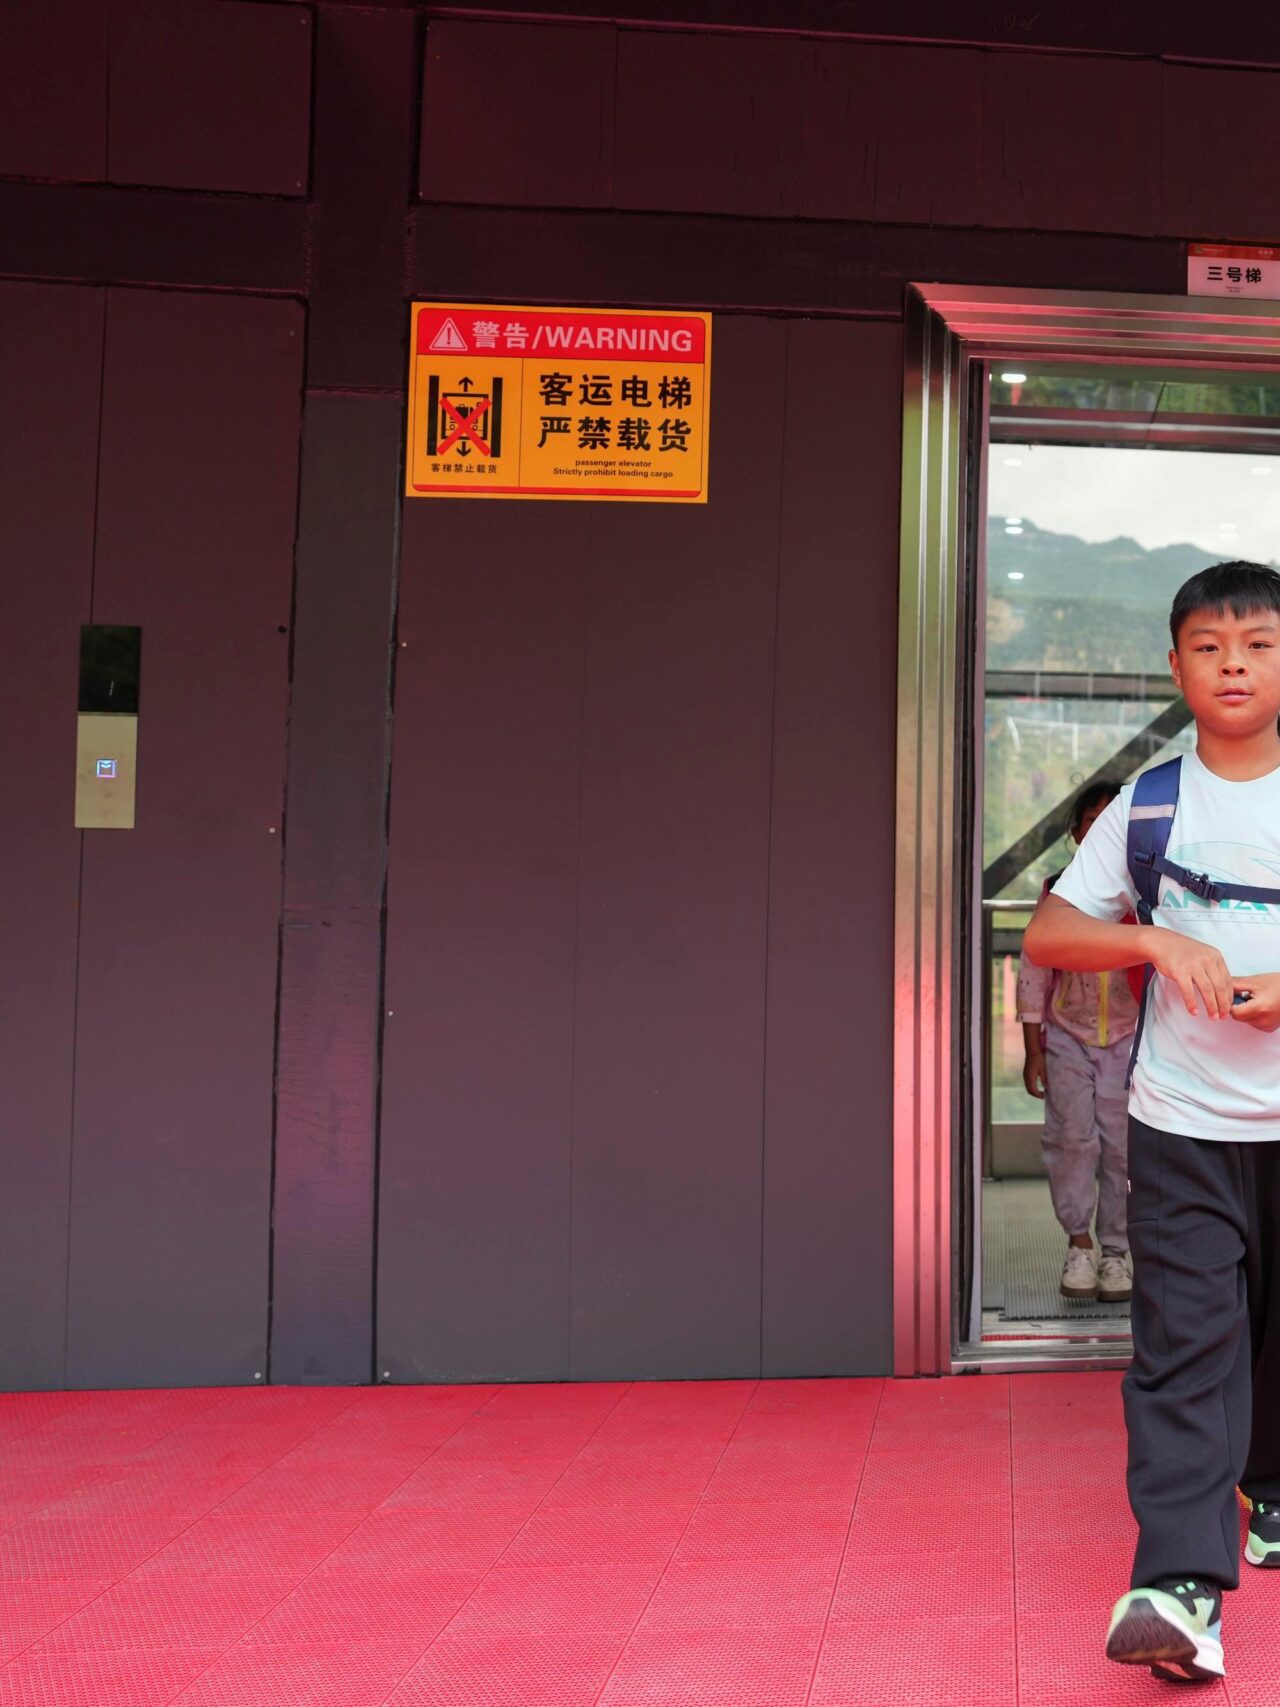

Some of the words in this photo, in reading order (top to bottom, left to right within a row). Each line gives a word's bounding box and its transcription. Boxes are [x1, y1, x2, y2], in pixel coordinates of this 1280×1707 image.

[1207, 266, 1262, 284] 三号梯
[472, 320, 693, 352] 警告/WARNING
[538, 372, 692, 409] 客运电梯
[537, 416, 692, 452] 严禁载货
[431, 463, 497, 474] 客梯禁止载货
[575, 459, 617, 467] passenger
[553, 467, 582, 476] Strictly
[584, 468, 616, 477] prohibit
[618, 469, 649, 478] loading
